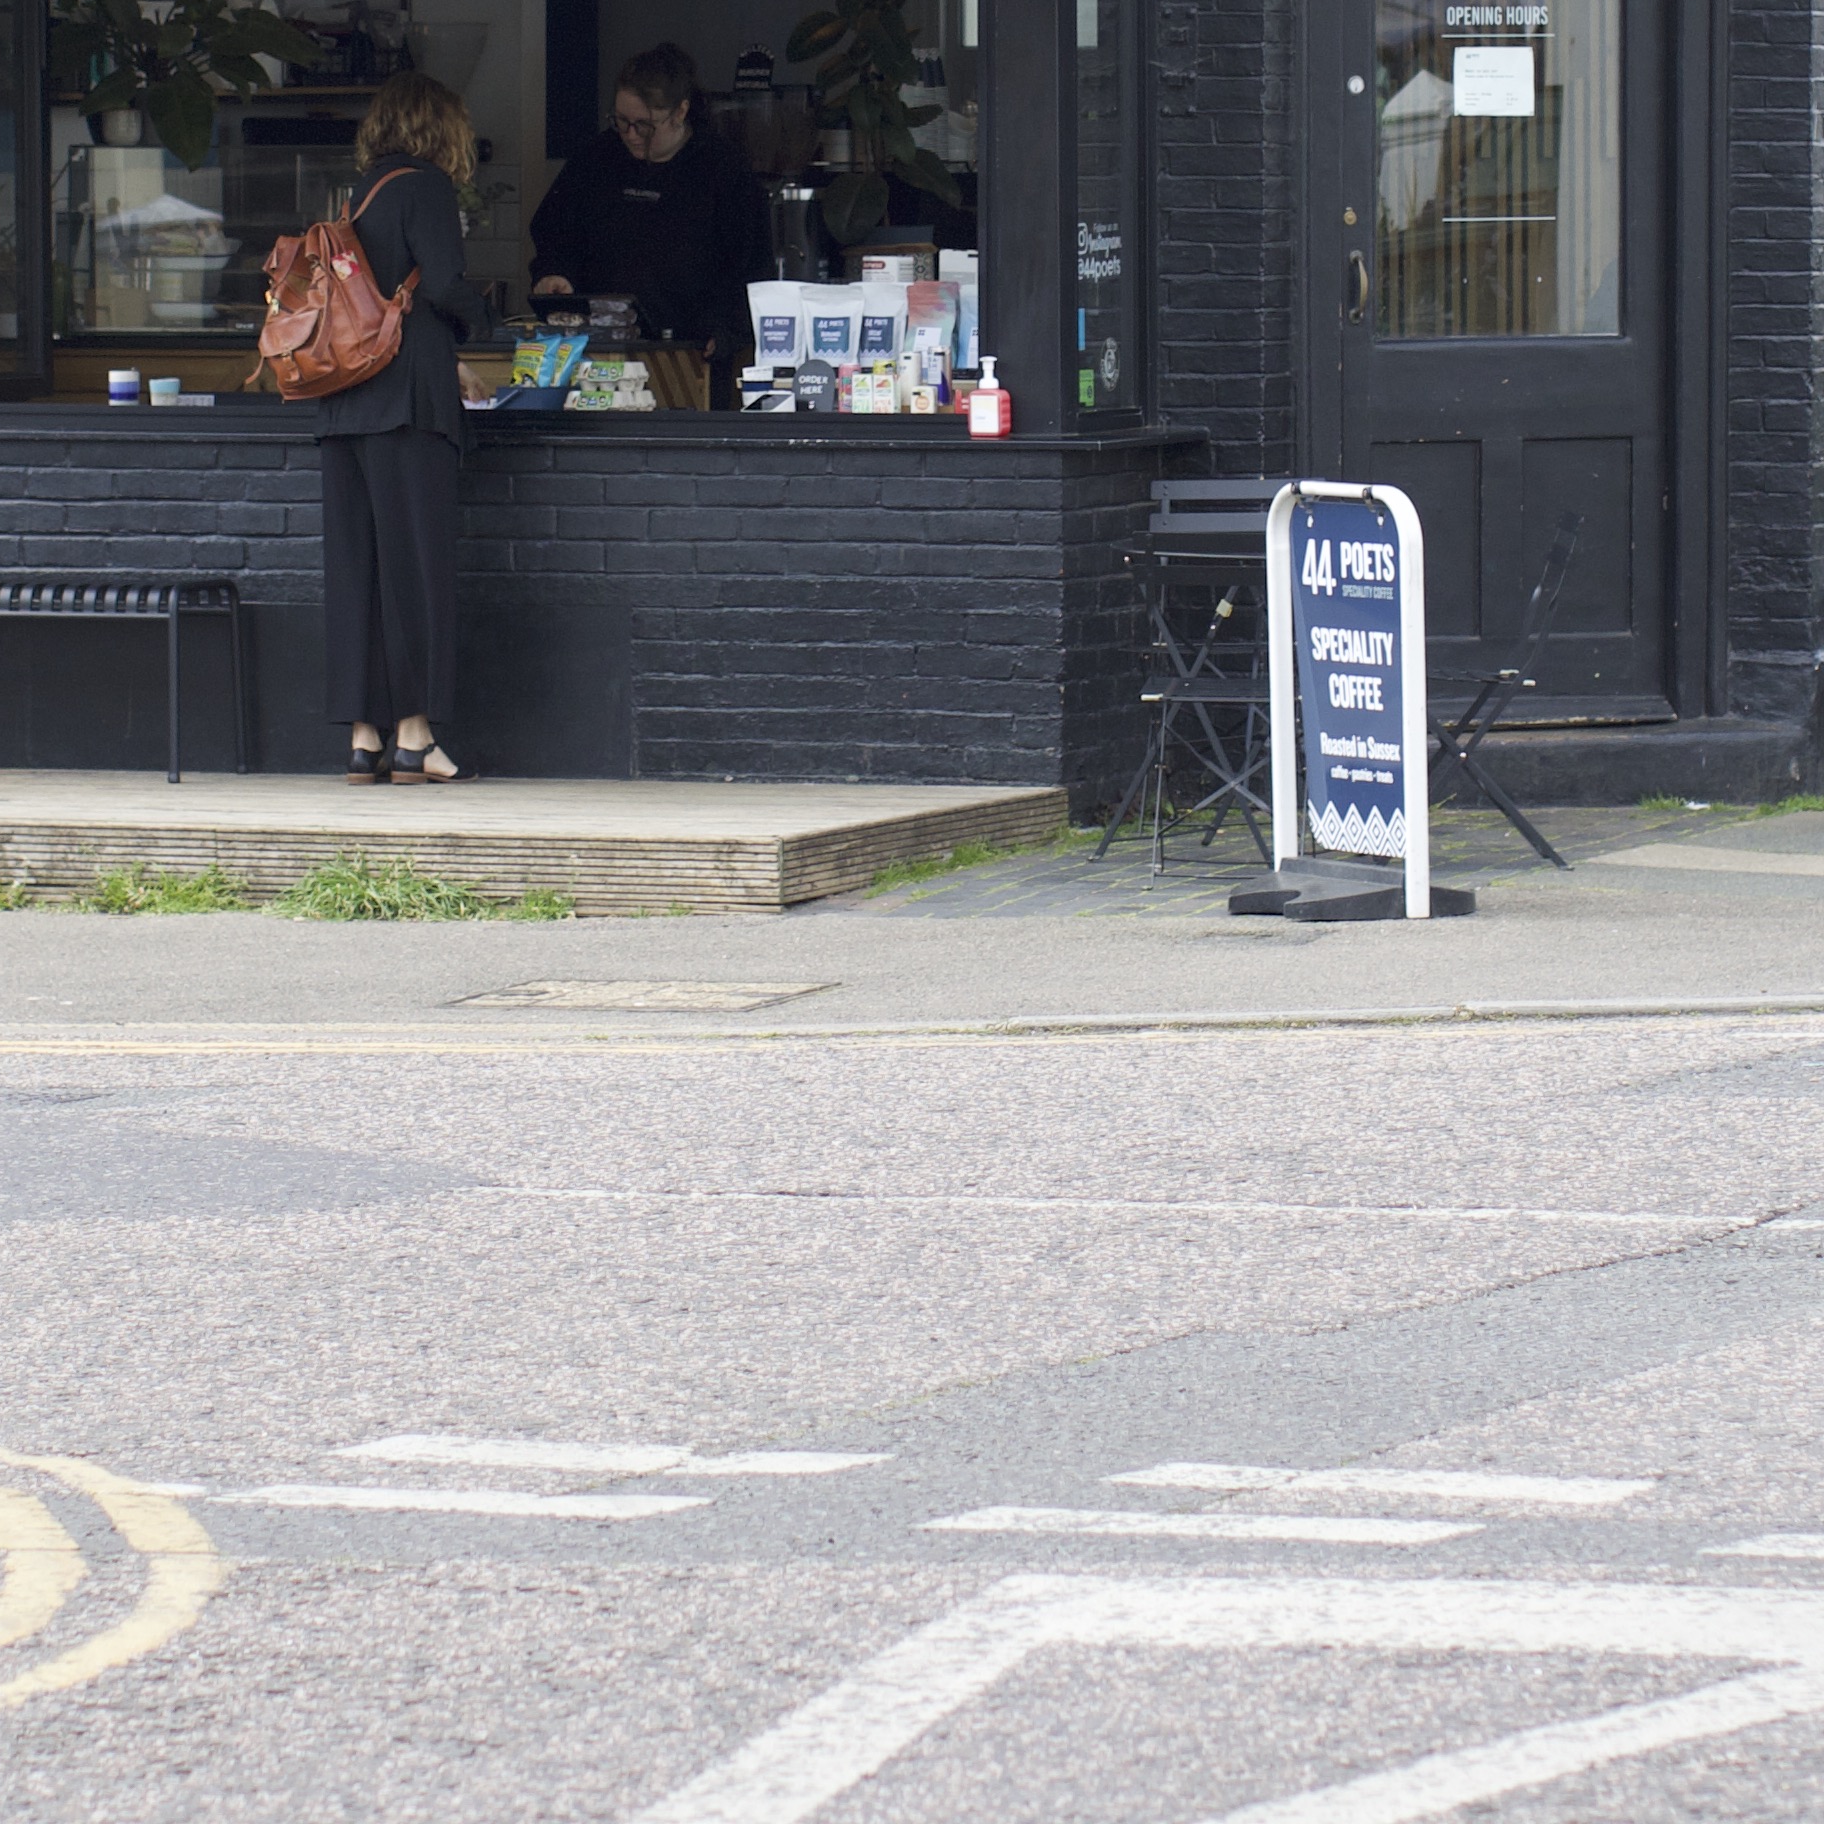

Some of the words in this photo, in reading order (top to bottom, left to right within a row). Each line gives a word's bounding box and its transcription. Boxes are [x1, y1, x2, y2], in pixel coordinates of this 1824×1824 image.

[1446, 6, 1503, 26] OPENING
[1505, 6, 1549, 26] HOURS
[798, 375, 829, 385] ORDER
[800, 385, 824, 395] HERE
[1339, 541, 1395, 582] POETS
[1342, 584, 1373, 598] SPECIALITY
[1373, 586, 1394, 600] COFFEE
[1311, 626, 1394, 666] SPECIALITY
[1328, 673, 1384, 712] COFFEE
[1320, 732, 1357, 758] Roasted
[1357, 736, 1367, 758] in
[1367, 736, 1401, 762] Sussex
